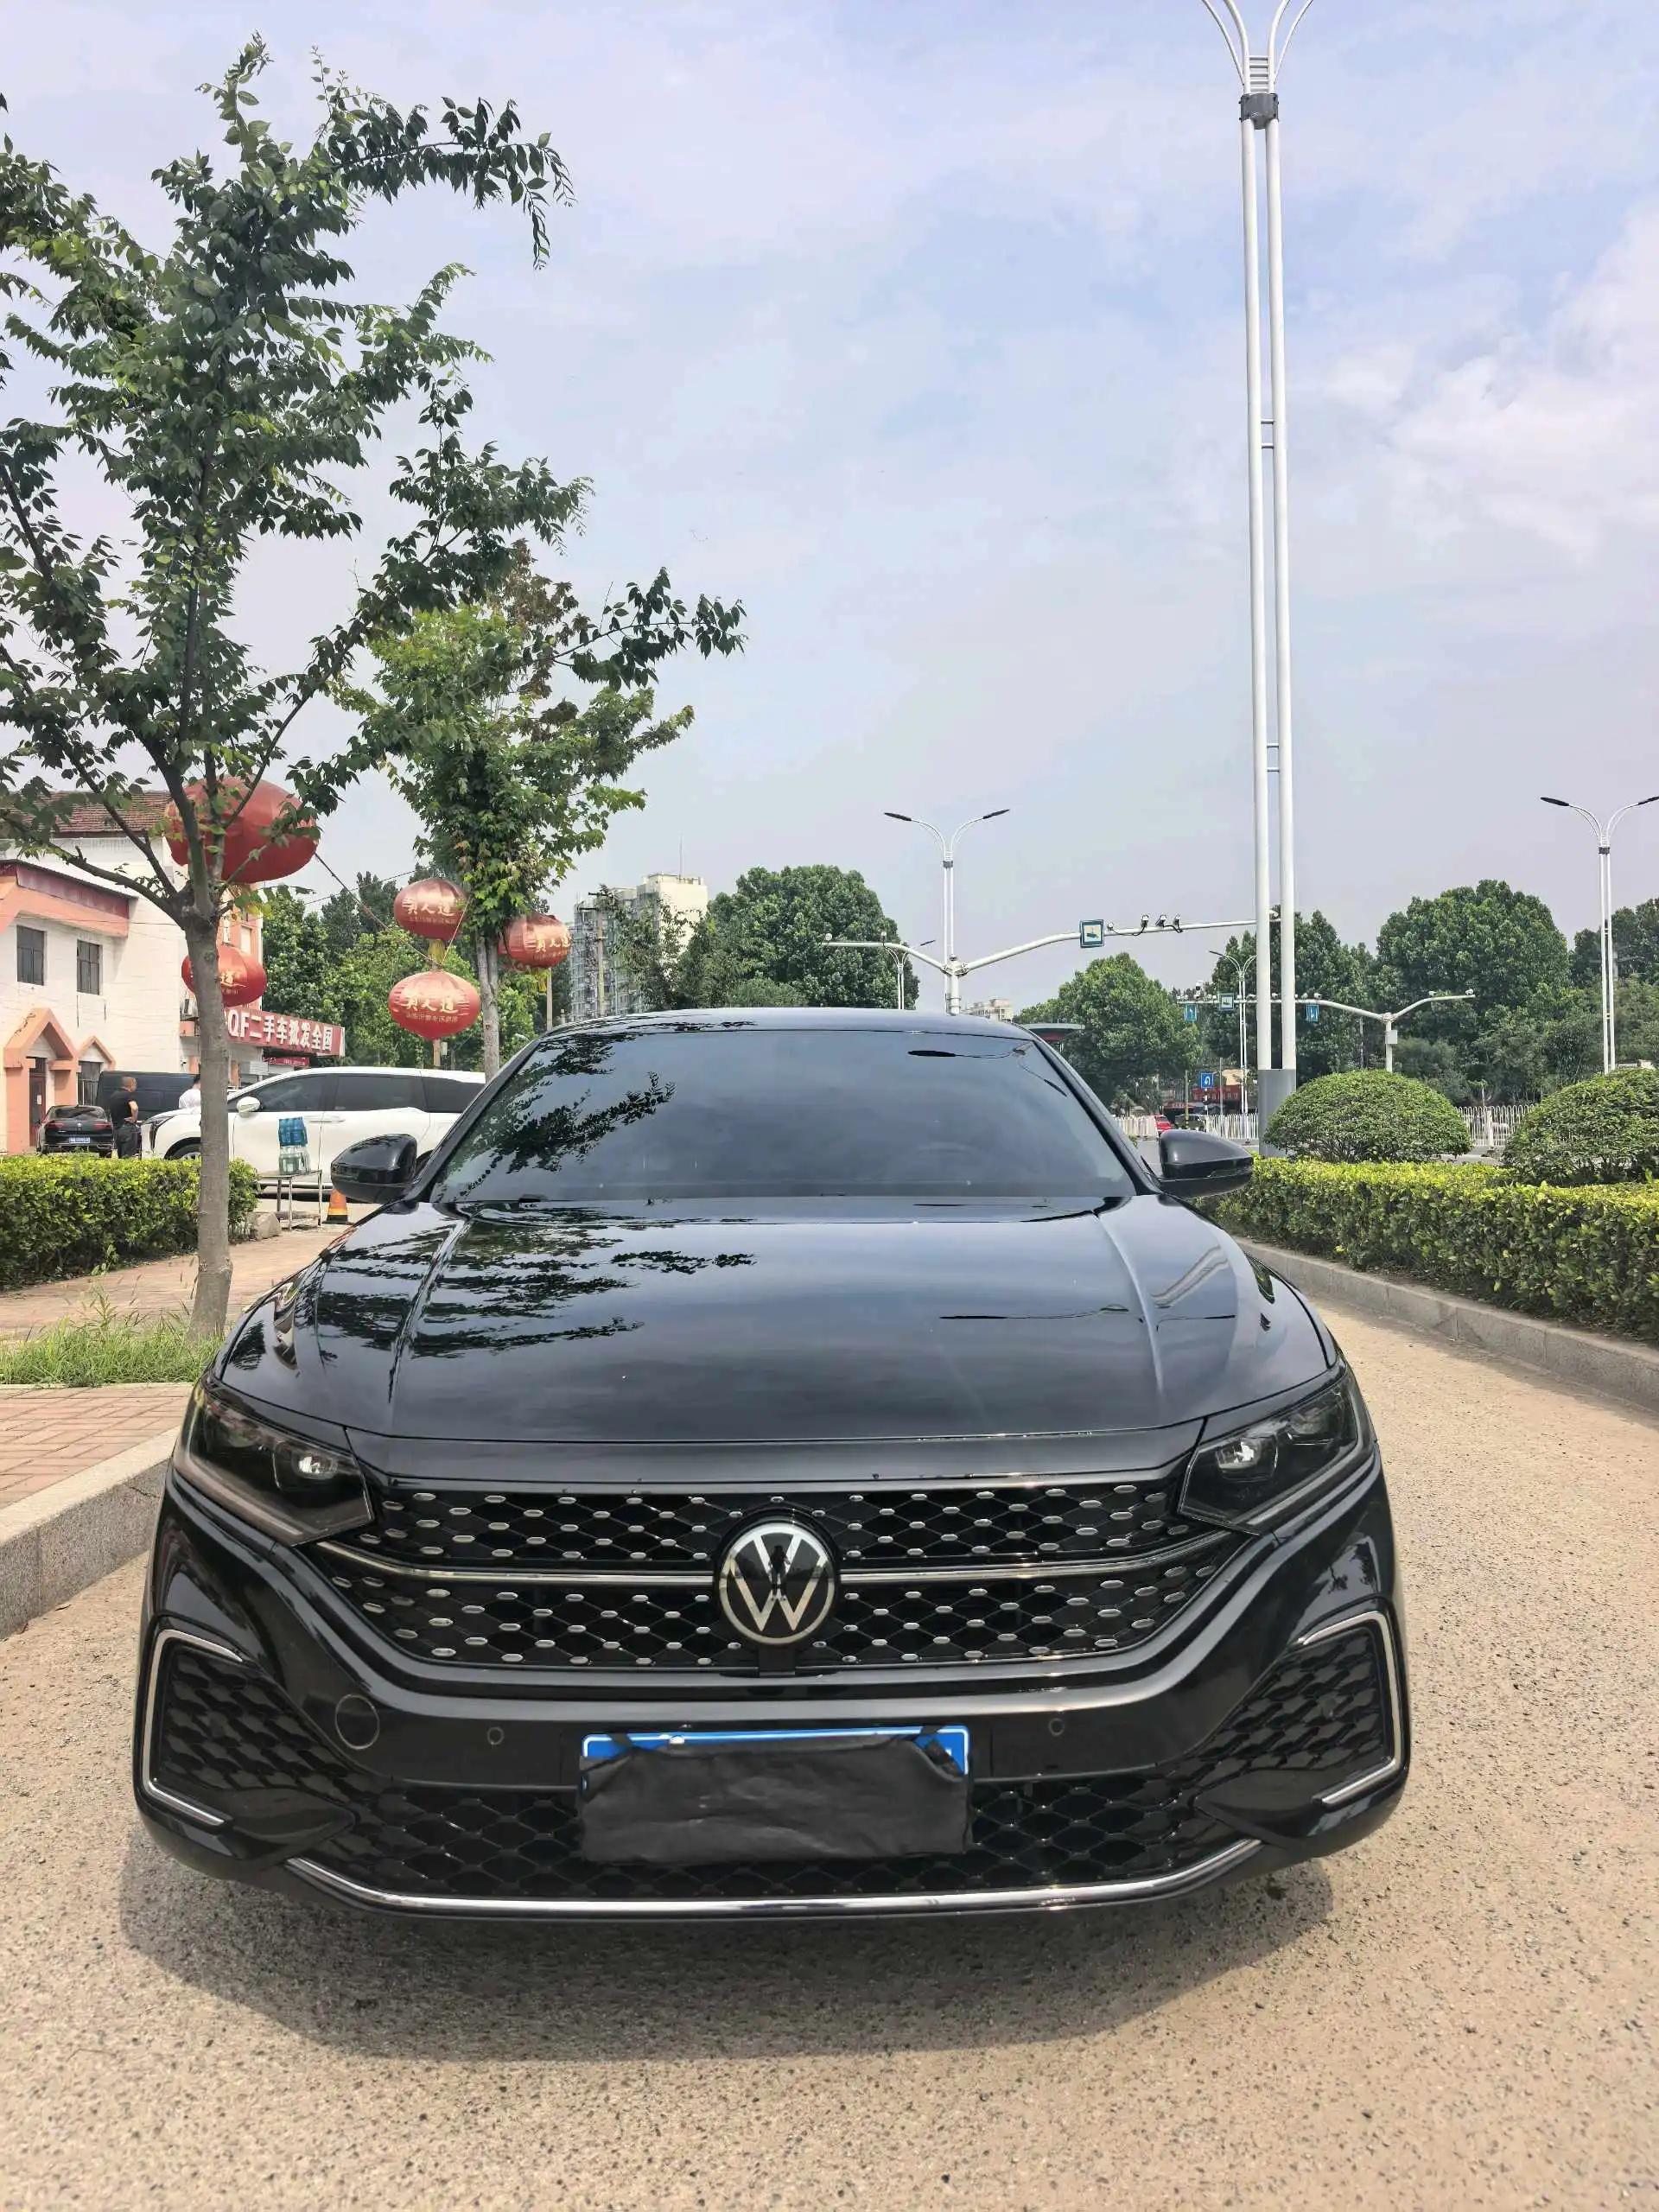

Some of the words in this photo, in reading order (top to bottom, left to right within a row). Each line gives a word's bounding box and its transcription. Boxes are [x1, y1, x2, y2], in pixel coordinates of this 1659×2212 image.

[225, 1009, 334, 1052] QF二手车批发全国
